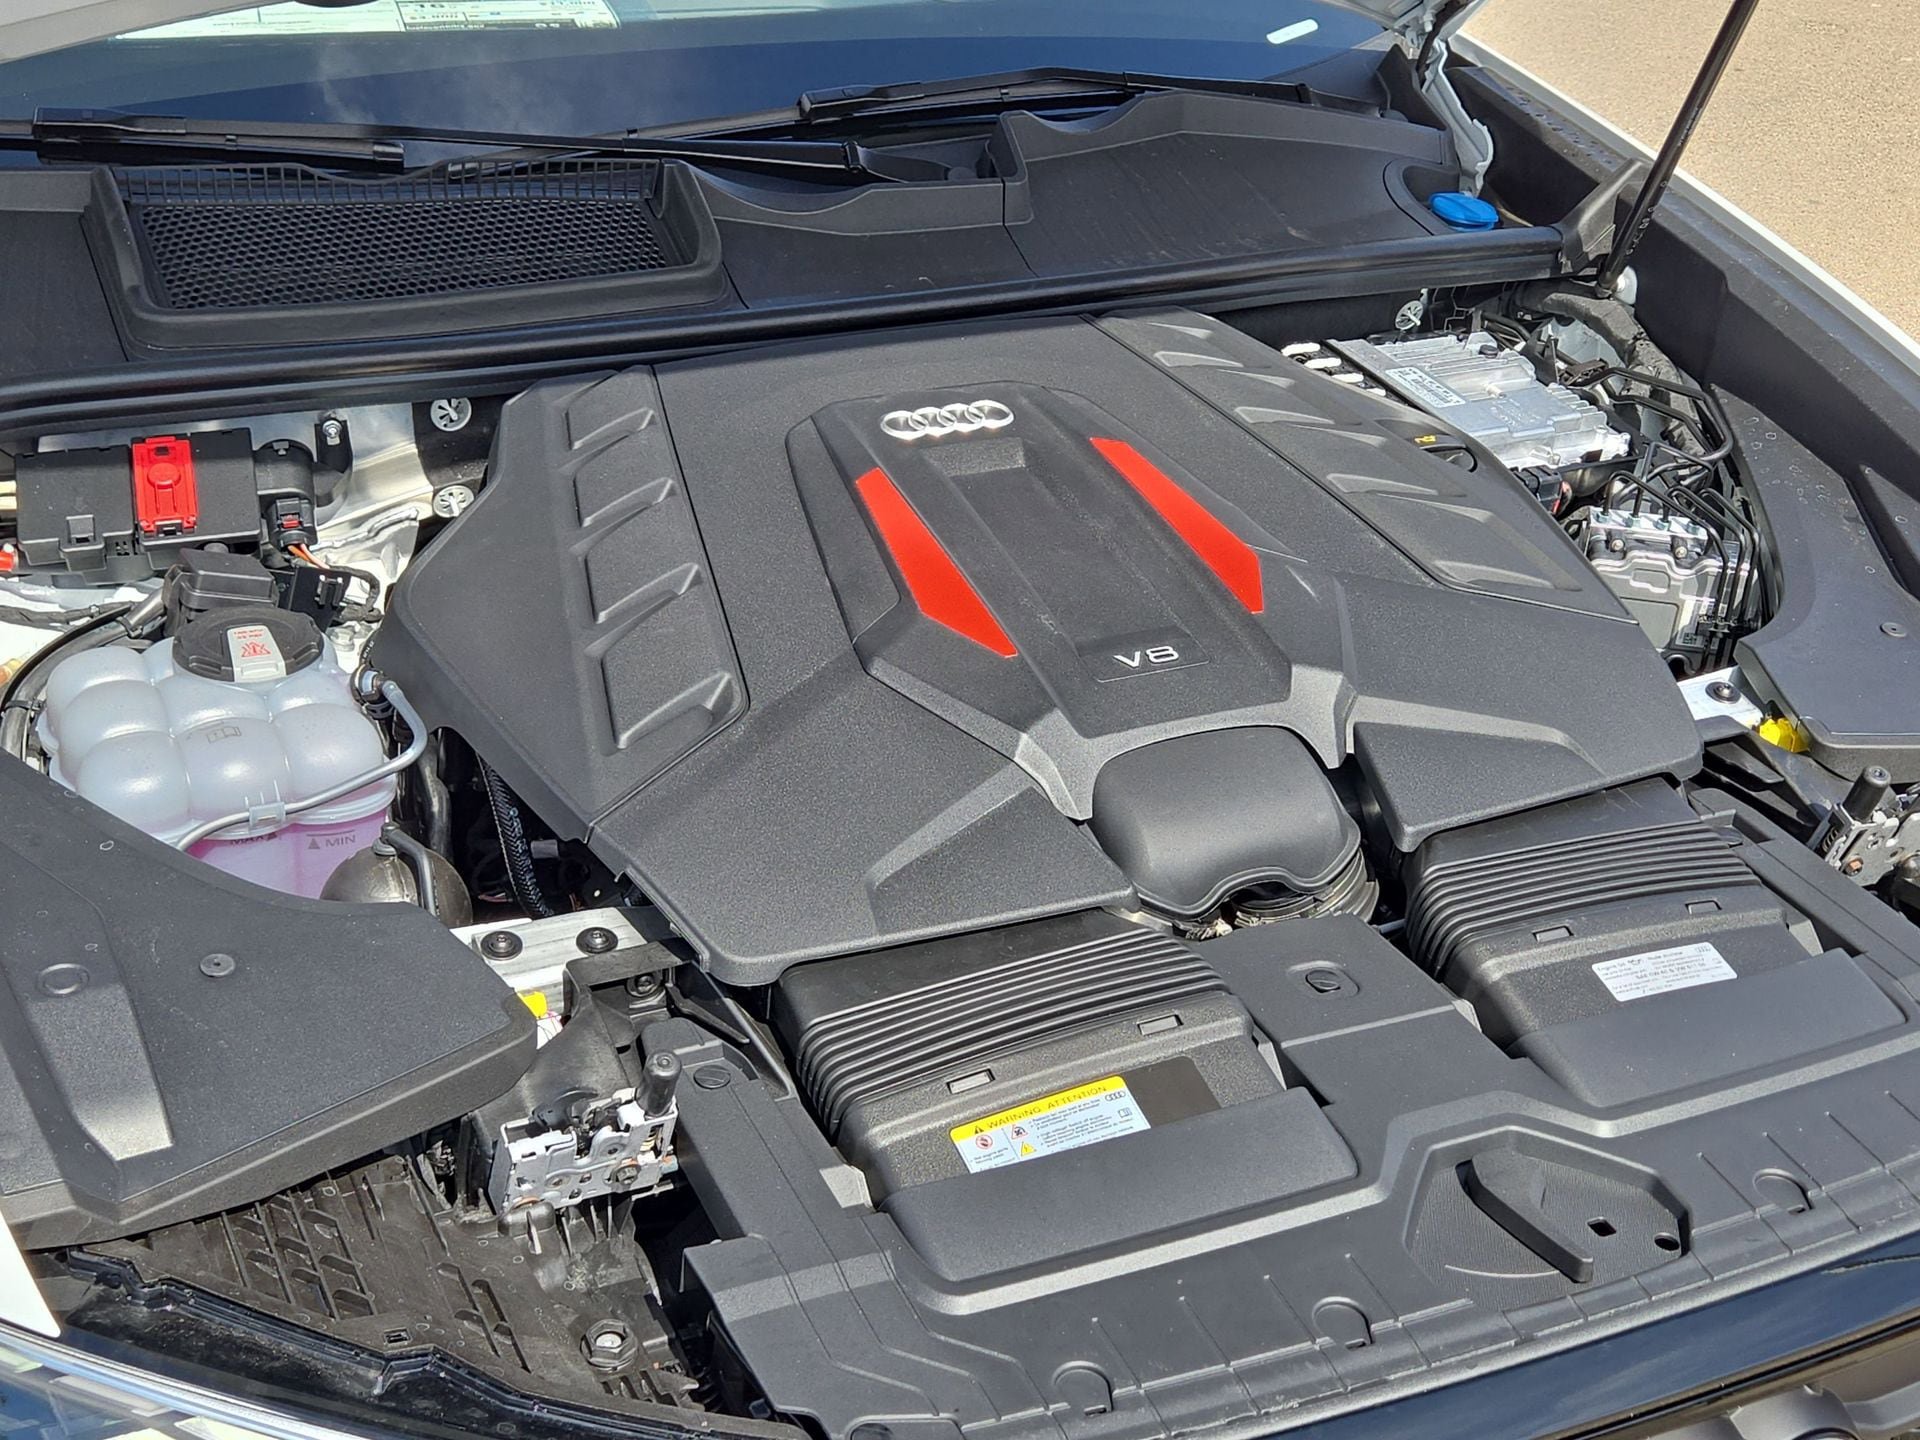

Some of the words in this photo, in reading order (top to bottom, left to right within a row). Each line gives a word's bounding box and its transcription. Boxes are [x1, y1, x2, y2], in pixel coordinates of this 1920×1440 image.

[1112, 645, 1179, 669] V8
[325, 834, 356, 848] MIN
[987, 1107, 1041, 1129] WARNING
[1047, 1086, 1107, 1109] ATTENTION
